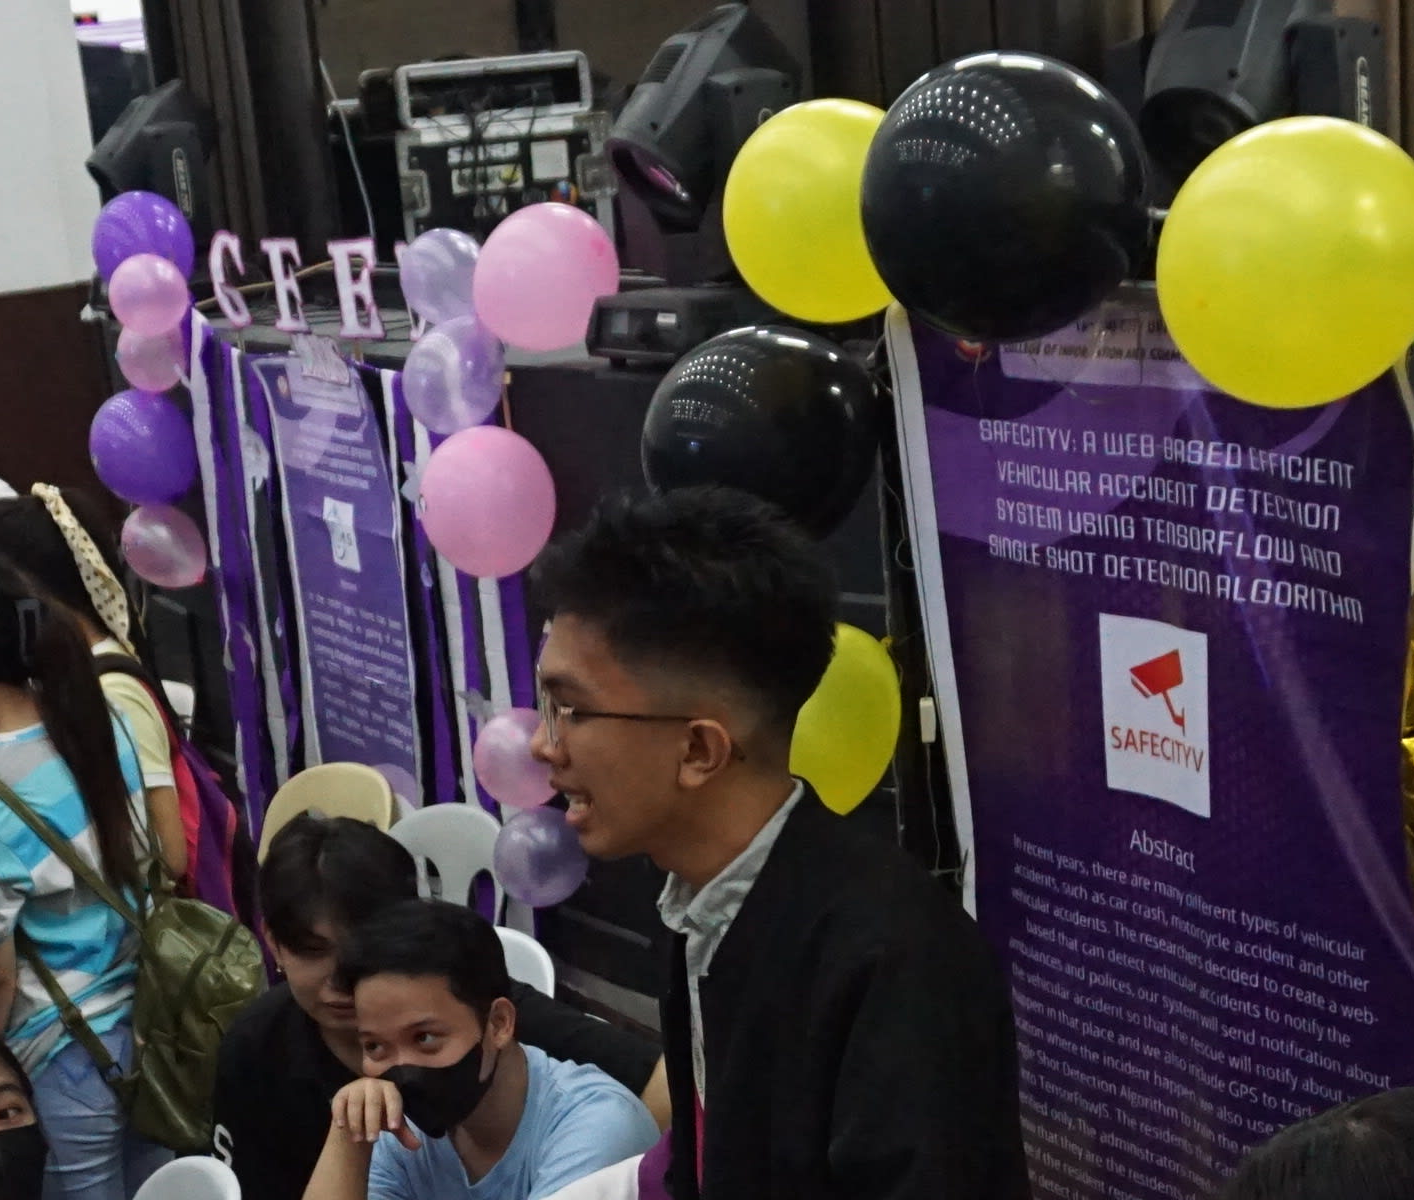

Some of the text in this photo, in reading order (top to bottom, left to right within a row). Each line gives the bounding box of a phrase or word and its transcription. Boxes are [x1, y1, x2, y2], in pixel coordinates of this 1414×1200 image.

[979, 419, 1077, 452] SAFECITYV:
[1083, 431, 1096, 453] A
[1249, 447, 1354, 489] EFFICIENT
[997, 460, 1339, 531] VEHICULAR ACCIDENT DETECTION
[988, 534, 1363, 624] SINGLE SHOT DETECTION ALGORITHM
[996, 498, 1341, 577] SYSTEM USING TENSORFLOW AND
[1111, 725, 1205, 773] SAFECITYV
[1130, 829, 1196, 873] Abstract
[1023, 840, 1055, 863] recent
[1092, 862, 1127, 885] there
[1130, 875, 1151, 891] are
[1153, 879, 1184, 907] many
[1241, 911, 1280, 936] types
[1283, 922, 1299, 940] of
[1301, 929, 1367, 961] vehicular
[1062, 882, 1088, 900] such
[1091, 890, 1106, 904] as
[1109, 895, 1127, 911] car
[1132, 900, 1169, 926] crash,
[1170, 913, 1230, 950] motorcycle
[1234, 940, 1294, 968] accident
[1299, 958, 1324, 979] and
[1327, 967, 1370, 993] other
[1026, 917, 1351, 1048] based that can detect vehicular accidents to notify the
[1053, 906, 1111, 934] accidents.
[1114, 920, 1136, 943] The
[1139, 932, 1203, 971] researchers
[1204, 957, 1259, 988] decided
[1263, 975, 1278, 994] to
[1282, 983, 1326, 1011] create
[1329, 999, 1337, 1013] a
[1341, 1002, 1379, 1026] web-
[1058, 1010, 1079, 1029] that
[1082, 1021, 1115, 1042] place
[1118, 1032, 1139, 1051] and
[1143, 1042, 1160, 1059] we
[1163, 1050, 1187, 1072] also
[1228, 1080, 1259, 1104] GPS
[1262, 1091, 1278, 1109] to
[1065, 962, 1085, 981] and
[1089, 971, 1135, 998] polices,
[1138, 987, 1159, 1004] our
[1162, 994, 1199, 1021] system
[1200, 1013, 1219, 1033] will
[1221, 1022, 1256, 1046] send
[1260, 1034, 1341, 1074] notification
[1345, 1063, 1391, 1090] about
[1073, 992, 1124, 1021] accident
[1126, 1009, 1140, 1025] so
[1143, 1015, 1170, 1037] that
[1171, 1024, 1188, 1045] the
[1191, 1036, 1226, 1064] rescue
[1228, 1055, 1252, 1074] will
[1256, 1063, 1299, 1091] notify
[1302, 1077, 1342, 1103] about
[1062, 1060, 1117, 1095] Detection
[1120, 1084, 1179, 1121] Algorithm
[1079, 1045, 1100, 1064] the
[1102, 1054, 1151, 1082] incident
[1216, 1108, 1243, 1127] also
[1246, 1118, 1275, 1135] use
[1115, 1108, 1137, 1128] The
[1086, 1149, 1103, 1167] are
[1105, 1156, 1127, 1177] the
